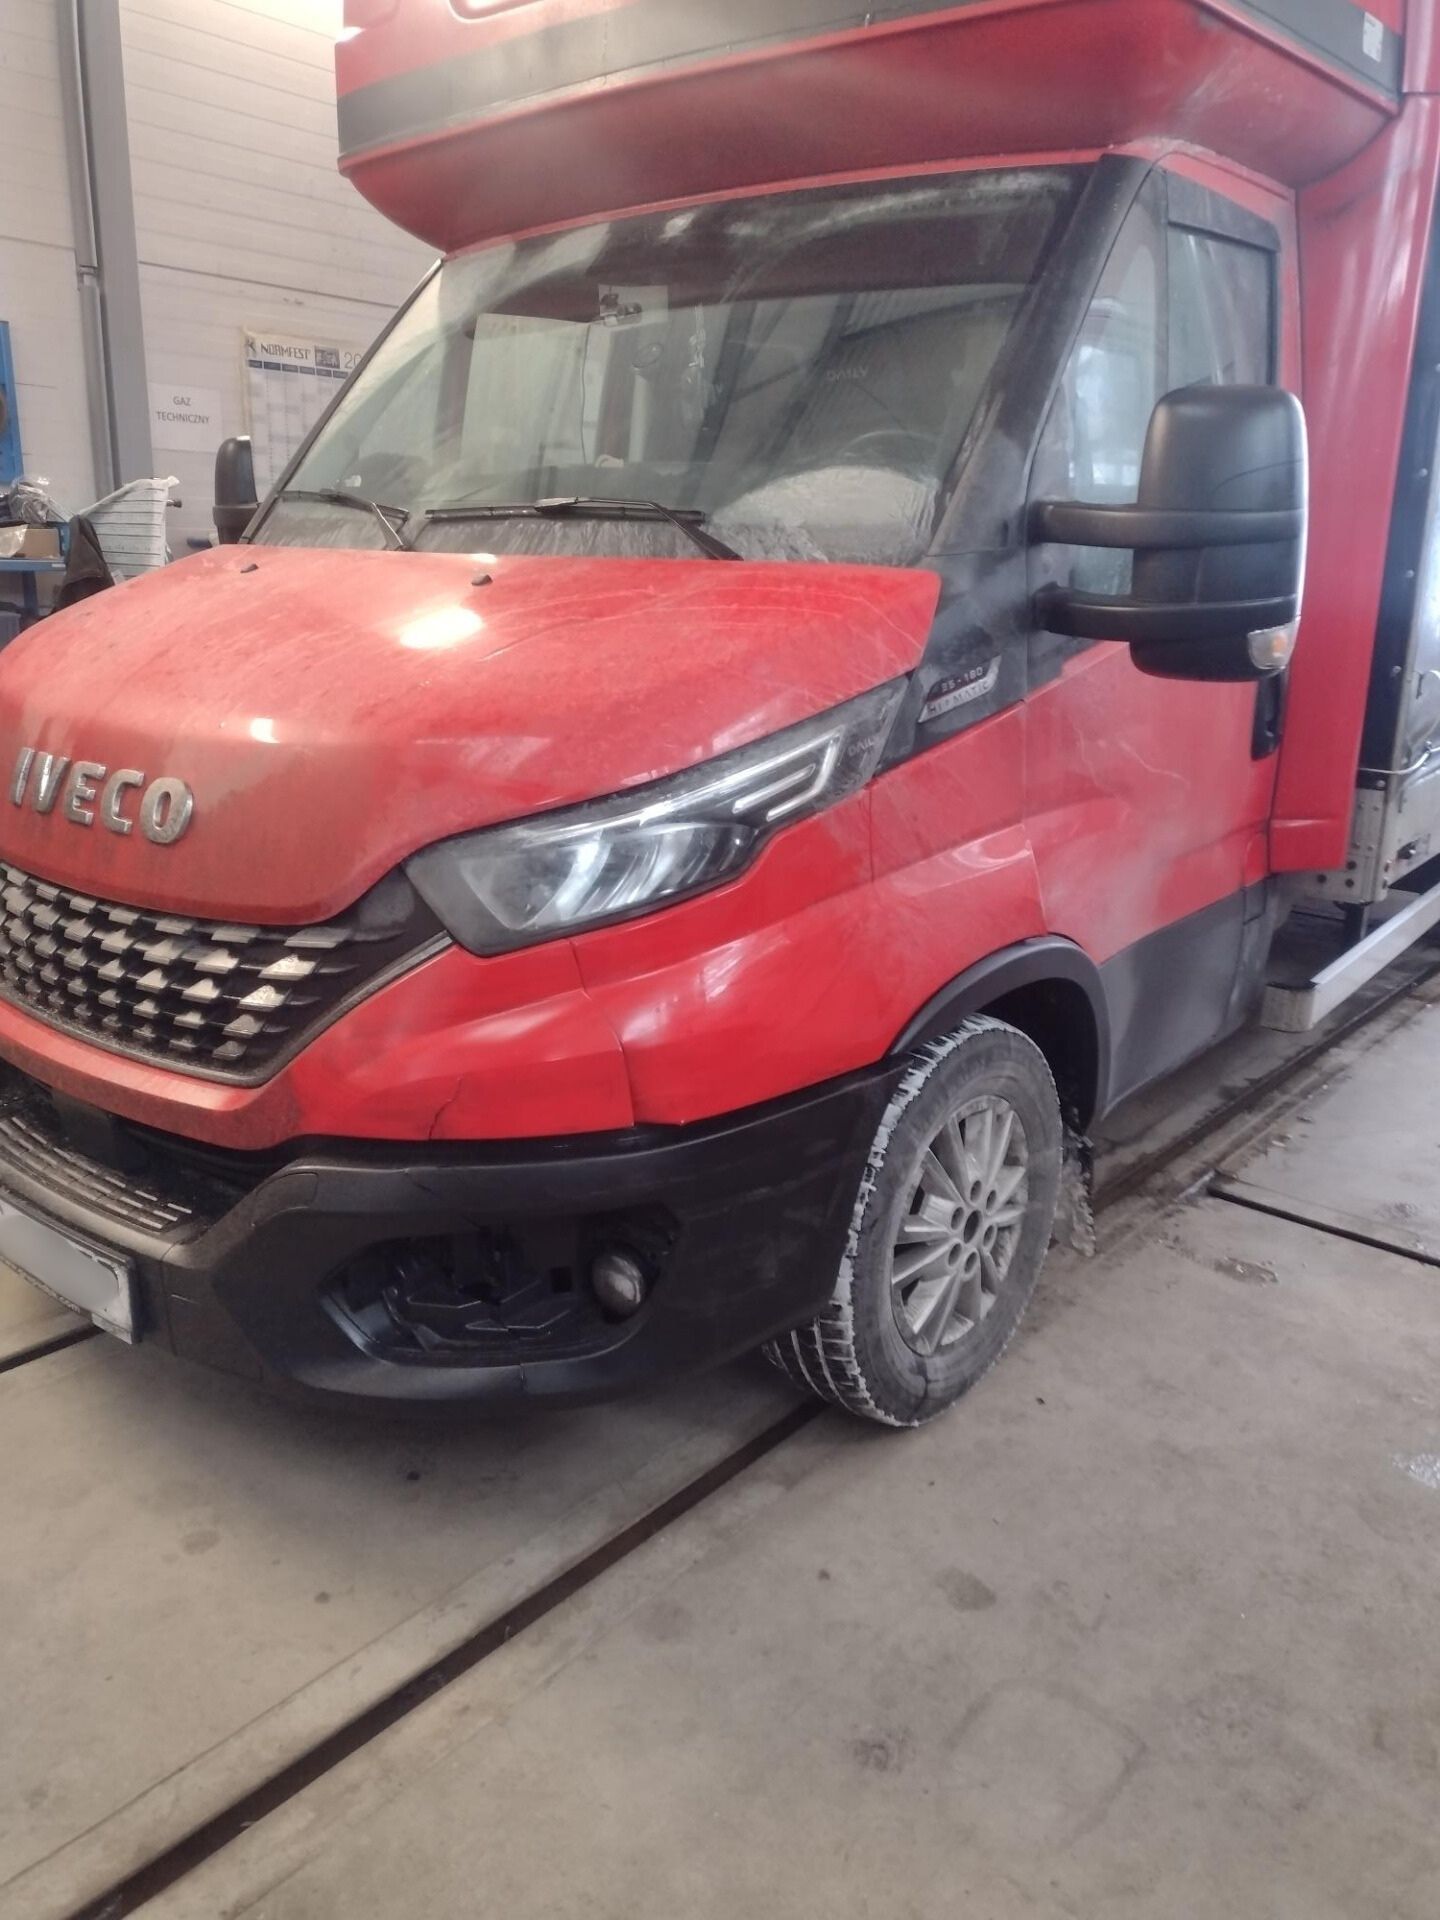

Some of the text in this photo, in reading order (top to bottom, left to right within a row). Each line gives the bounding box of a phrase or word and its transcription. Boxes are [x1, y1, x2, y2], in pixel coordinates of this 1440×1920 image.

[260, 343, 311, 360] NORMFEST
[172, 396, 192, 406] GAZ
[156, 411, 210, 424] TECHNICZNY
[10, 747, 195, 844] IVECO
